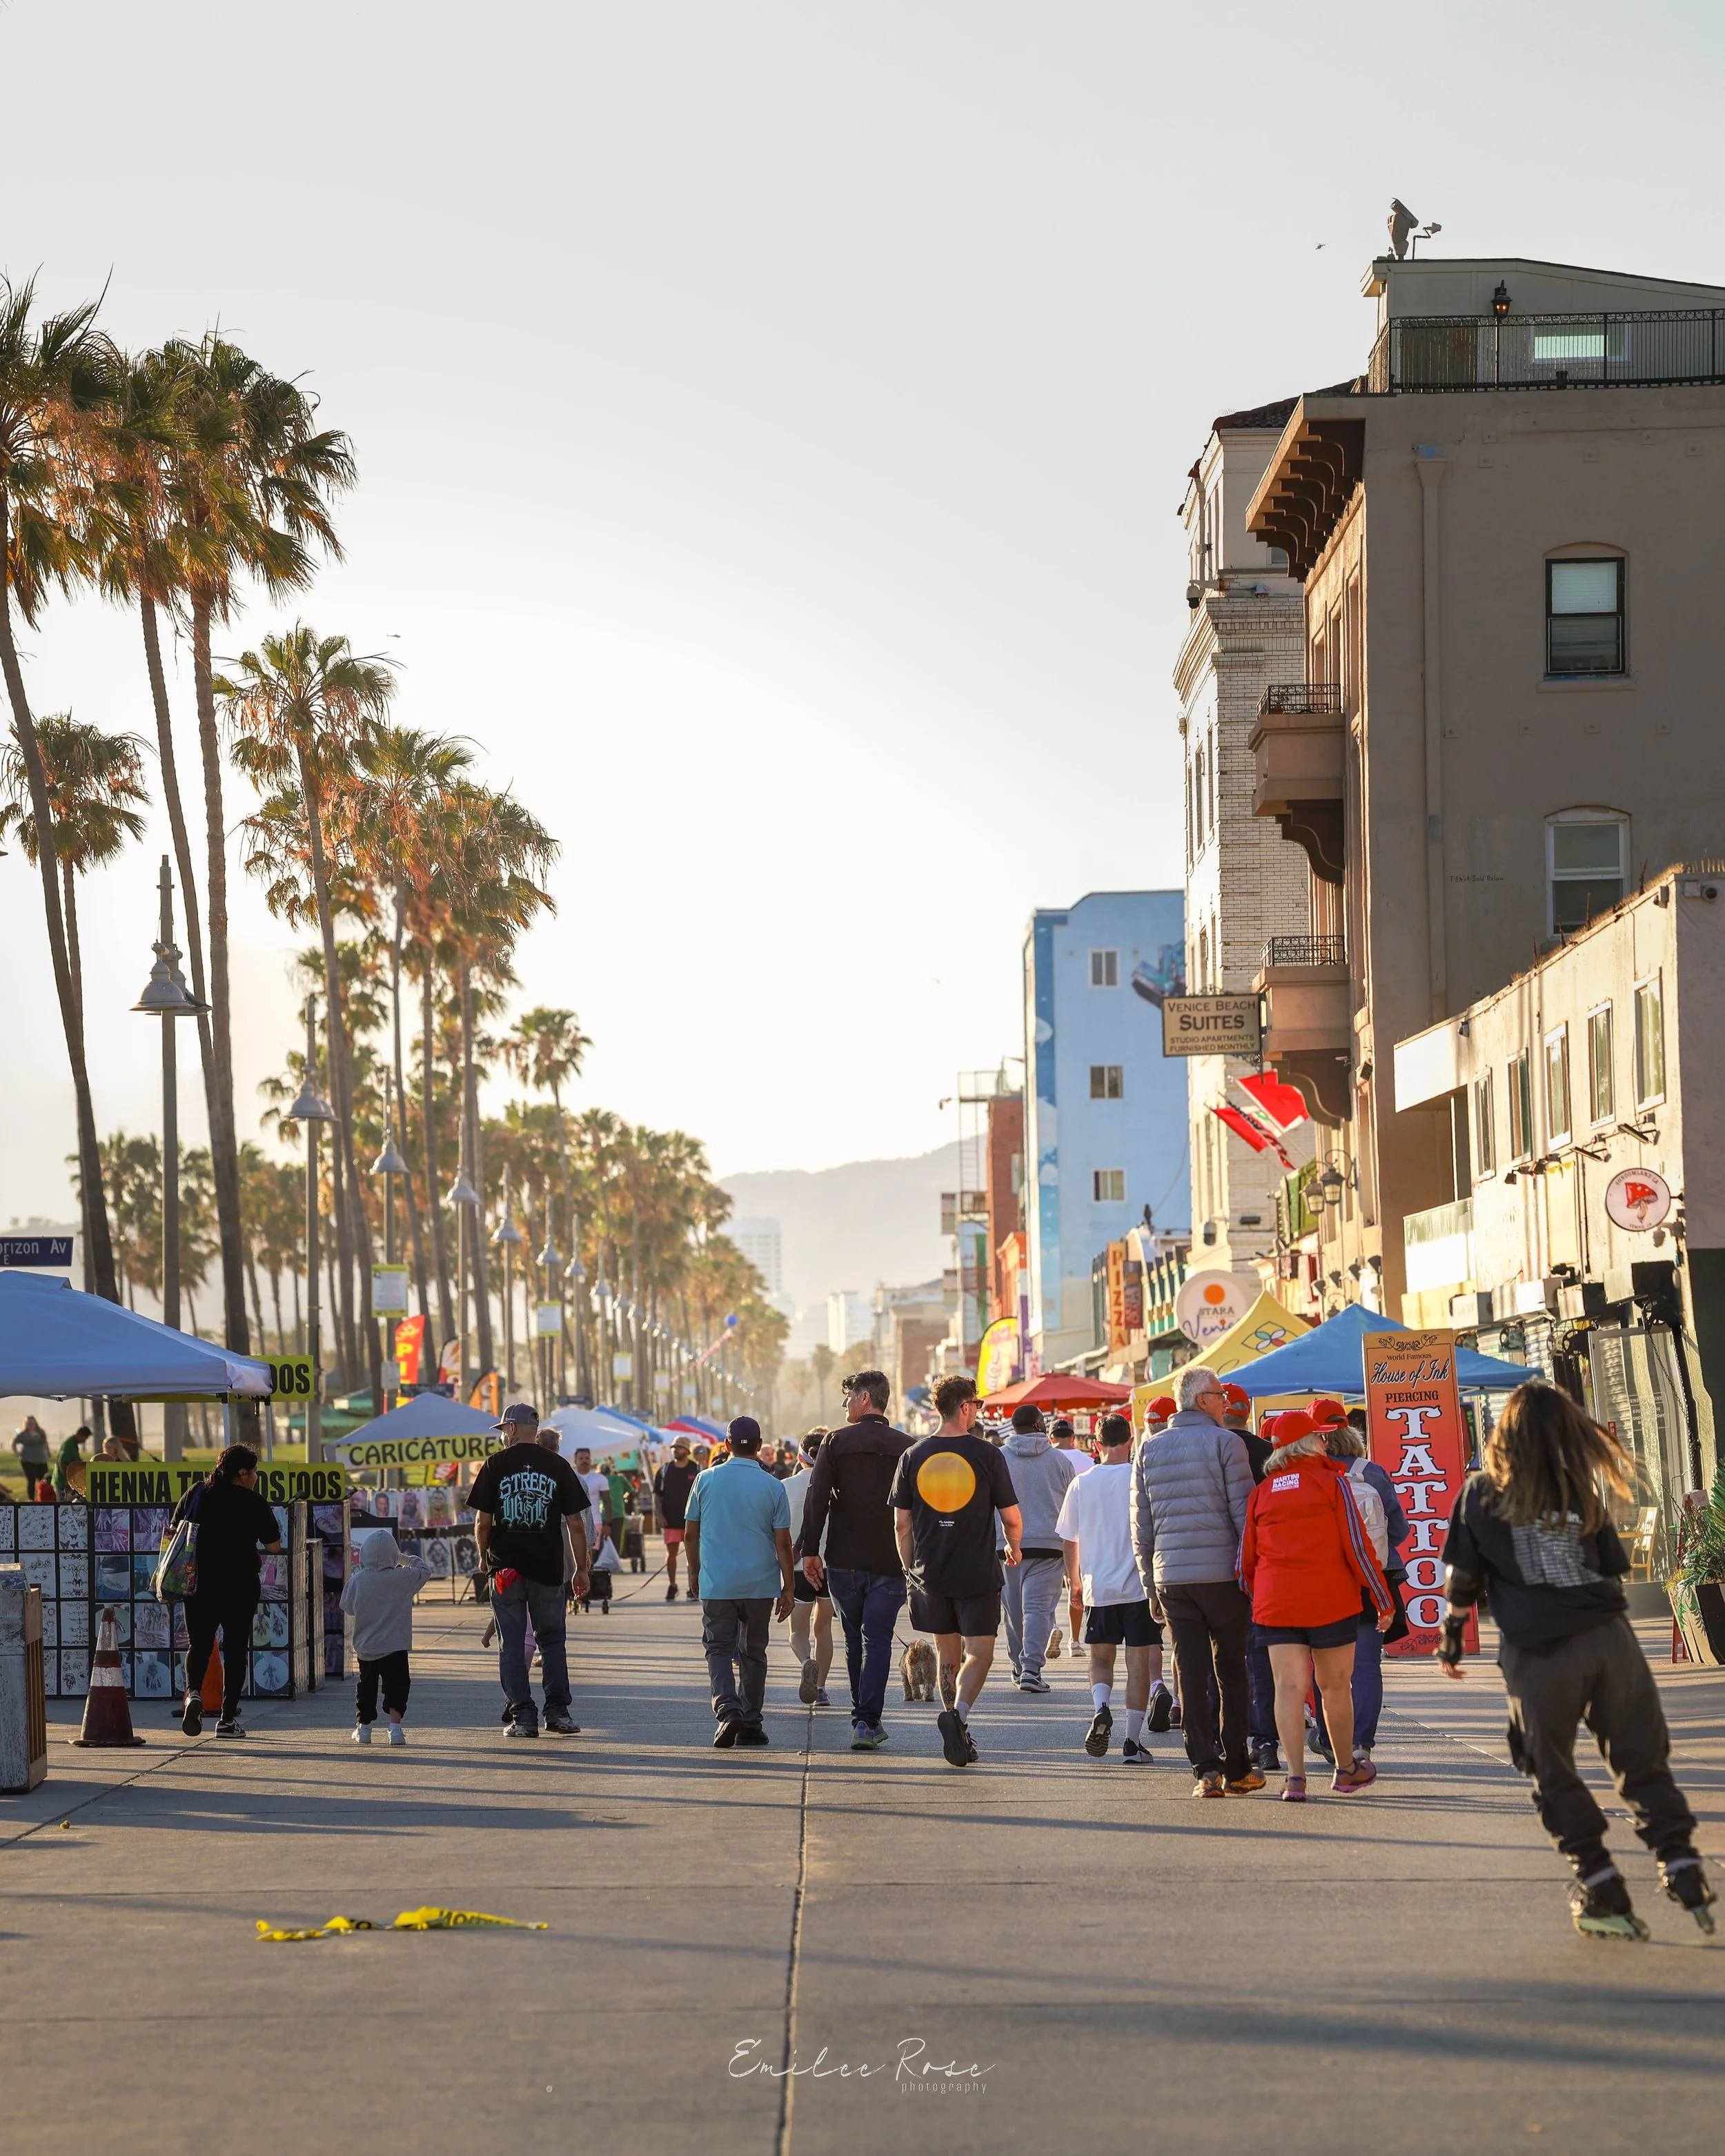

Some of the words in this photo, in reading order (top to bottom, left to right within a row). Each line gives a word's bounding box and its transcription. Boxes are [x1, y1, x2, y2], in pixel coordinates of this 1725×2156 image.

[1167, 1002, 1210, 1012] VENICE
[1216, 1000, 1255, 1011] BEACH
[1179, 1014, 1245, 1031] SUITES
[1201, 1034, 1254, 1042] APARTMENTS
[1217, 1042, 1255, 1051] MONTHLY
[50, 1239, 66, 1254] Av
[1113, 1250, 1126, 1347] PIZZA
[1182, 1314, 1241, 1339] Venic
[1370, 1361, 1407, 1385] House
[1409, 1360, 1426, 1389] of
[1422, 1358, 1451, 1382] Ink
[1386, 1390, 1439, 1403] PIERCING
[499, 1472, 557, 1499] STREET
[1272, 1478, 1299, 1489] RACING
[1273, 1473, 1300, 1483] MARTINI
[90, 1472, 172, 1503] HENNA
[1386, 1405, 1450, 1628] TATTOO
